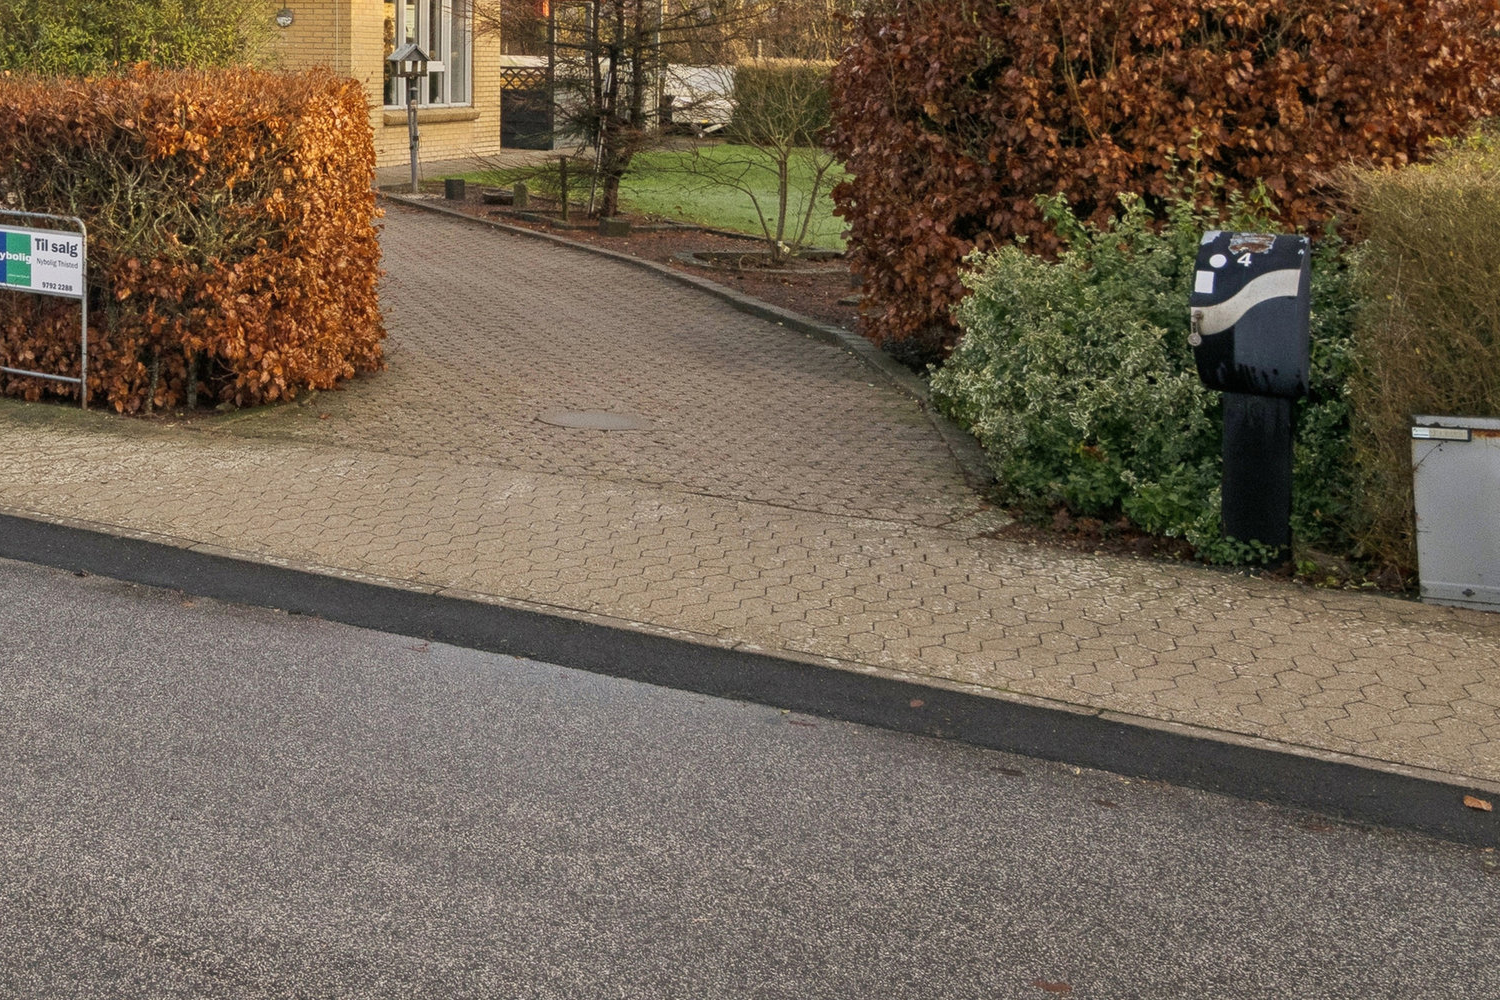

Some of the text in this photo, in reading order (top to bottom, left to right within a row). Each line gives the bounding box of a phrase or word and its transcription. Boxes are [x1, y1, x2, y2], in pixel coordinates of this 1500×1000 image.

[35, 238, 78, 258] Til salg
[36, 257, 78, 269] Nybolig Thisted
[1237, 253, 1252, 267] 4
